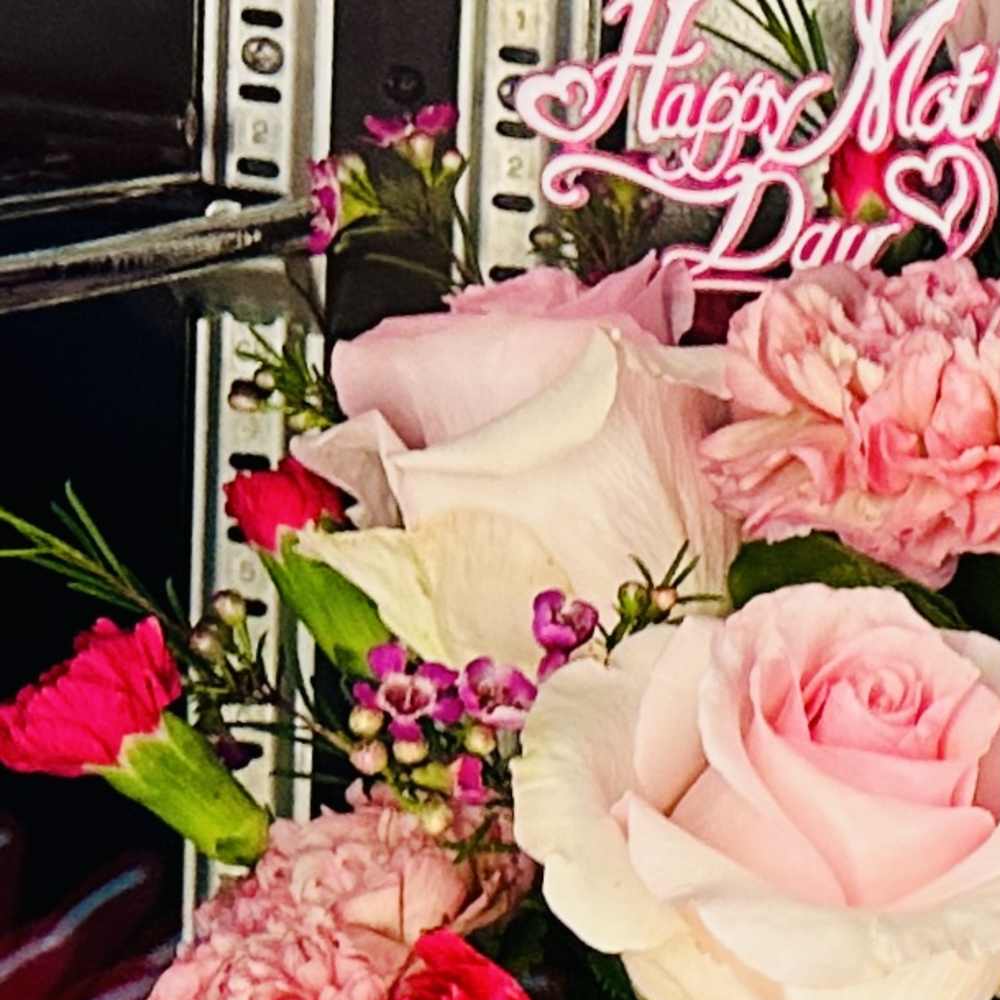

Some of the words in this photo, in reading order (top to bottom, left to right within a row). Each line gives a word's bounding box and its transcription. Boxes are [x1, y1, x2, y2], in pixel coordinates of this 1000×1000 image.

[516, 9, 527, 31] 1
[585, 0, 832, 182] Happy
[506, 156, 523, 179] 2
